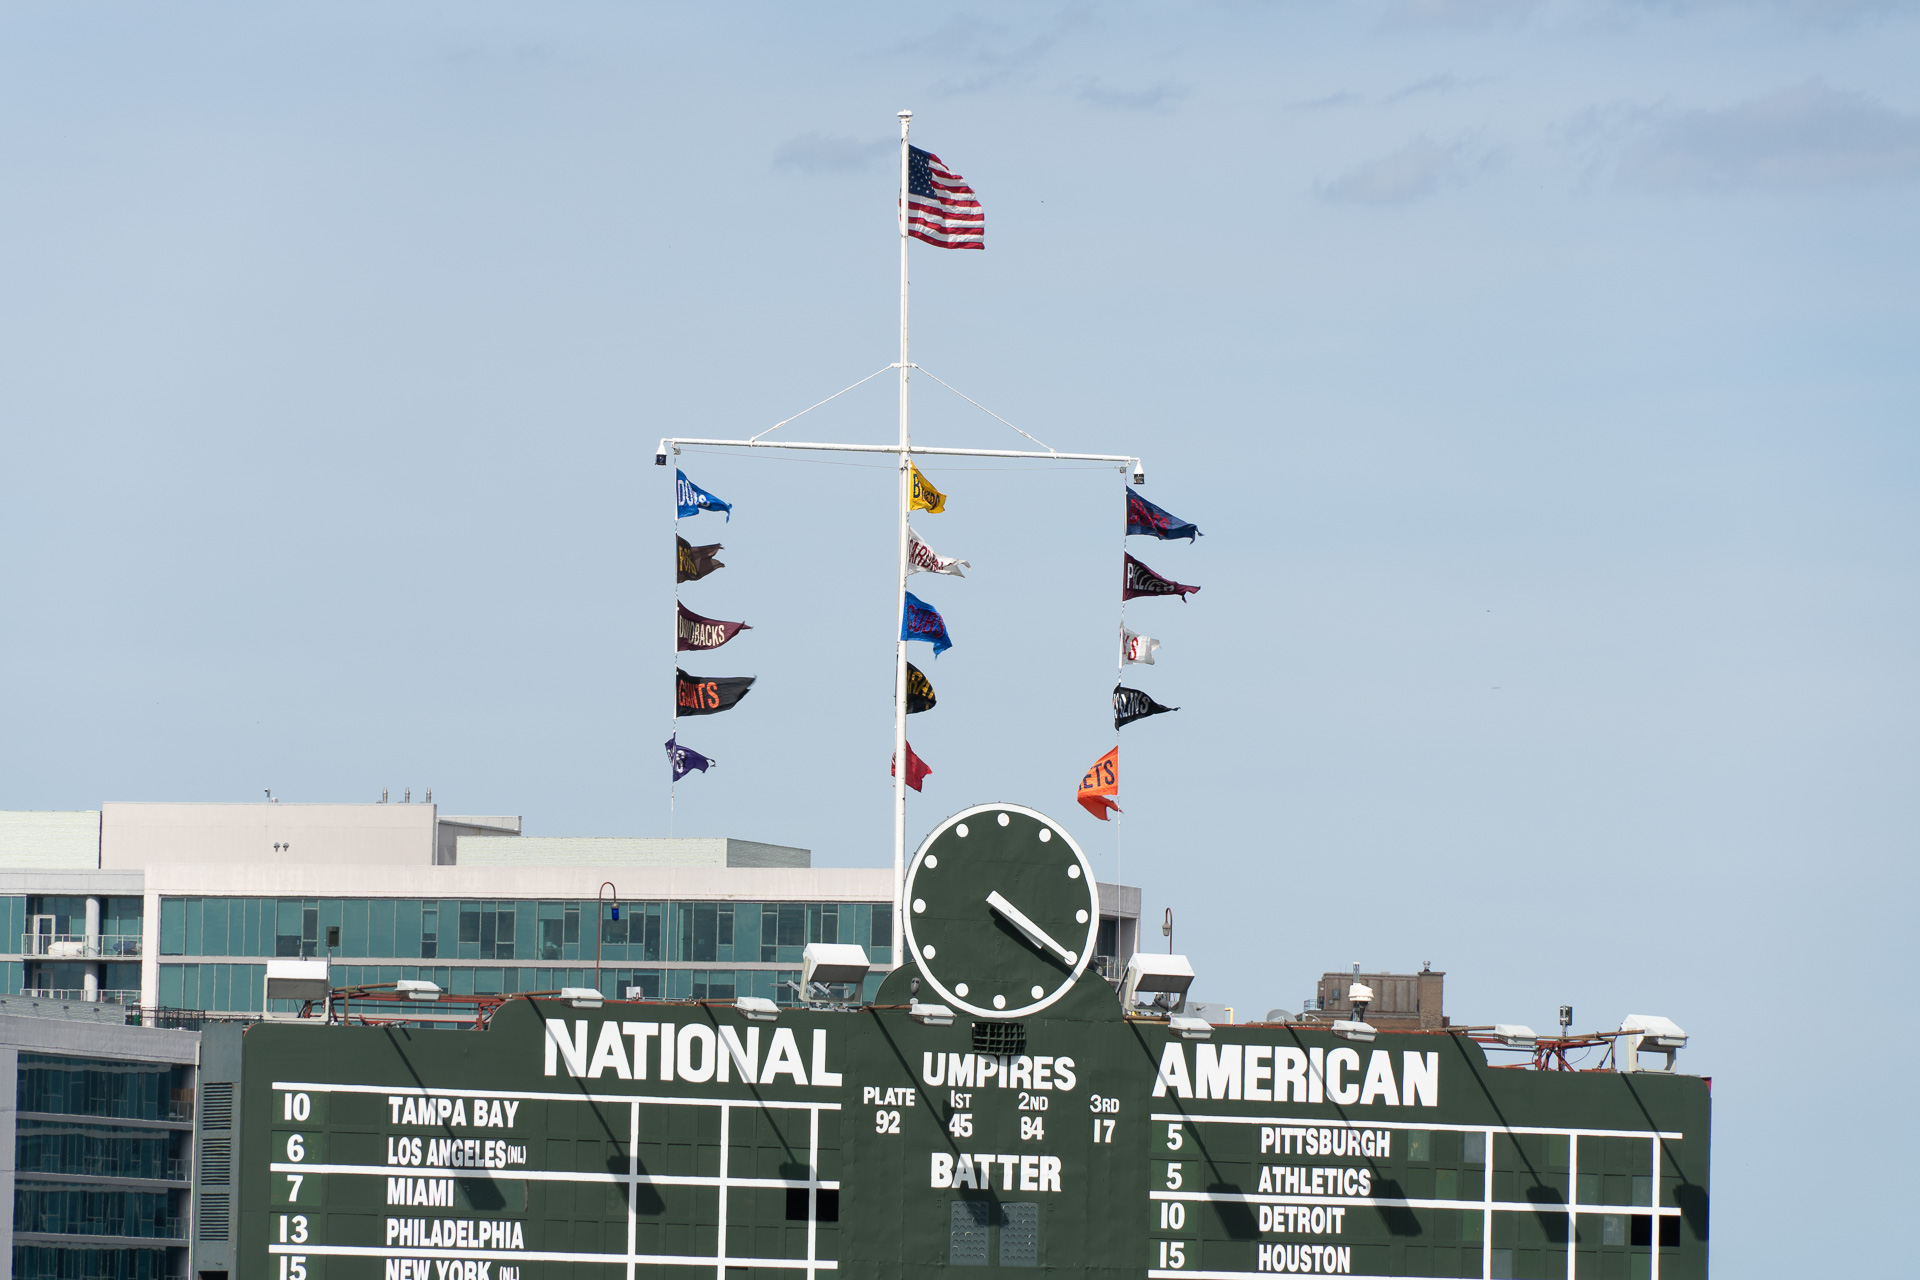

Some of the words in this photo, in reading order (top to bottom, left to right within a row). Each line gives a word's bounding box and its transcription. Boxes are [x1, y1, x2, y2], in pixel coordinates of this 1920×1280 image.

[907, 604, 945, 638] CUBS
[545, 1018, 842, 1087] NATIONAL
[923, 1051, 1077, 1091] UMPIRES
[1152, 1042, 1439, 1107] AMERICAN
[284, 1092, 311, 1121] 10
[863, 1086, 916, 1107] PLATE
[1018, 1091, 1049, 1111] 2ND
[1090, 1094, 1120, 1114] 3RD
[388, 1096, 467, 1127] TAMPA
[474, 1099, 519, 1128] BAY
[875, 1110, 901, 1134] 92
[948, 1113, 973, 1138] 45
[1020, 1116, 1045, 1141] 84
[1093, 1118, 1116, 1144] 17
[1166, 1123, 1183, 1150] 5
[1260, 1126, 1391, 1158] PITTSBURGH
[286, 1133, 305, 1161] 6
[387, 1137, 422, 1166] LOS
[426, 1139, 507, 1169] ANGELES
[507, 1144, 527, 1165] (NL)
[930, 1152, 1062, 1192] BATTER
[1165, 1162, 1183, 1190] 5
[1257, 1166, 1372, 1197] ATHLETICS
[286, 1174, 304, 1202] 7
[387, 1177, 455, 1207] MIAMI
[279, 1214, 309, 1244] 13
[1160, 1202, 1186, 1230] 10
[1258, 1206, 1346, 1235] DETROIT
[386, 1217, 525, 1250] PHILADELPHIA
[280, 1255, 307, 1280] 15
[385, 1258, 432, 1280] NEW
[436, 1259, 491, 1280] YORK
[1159, 1241, 1186, 1269] 15
[1257, 1244, 1351, 1275] HOUSTON
